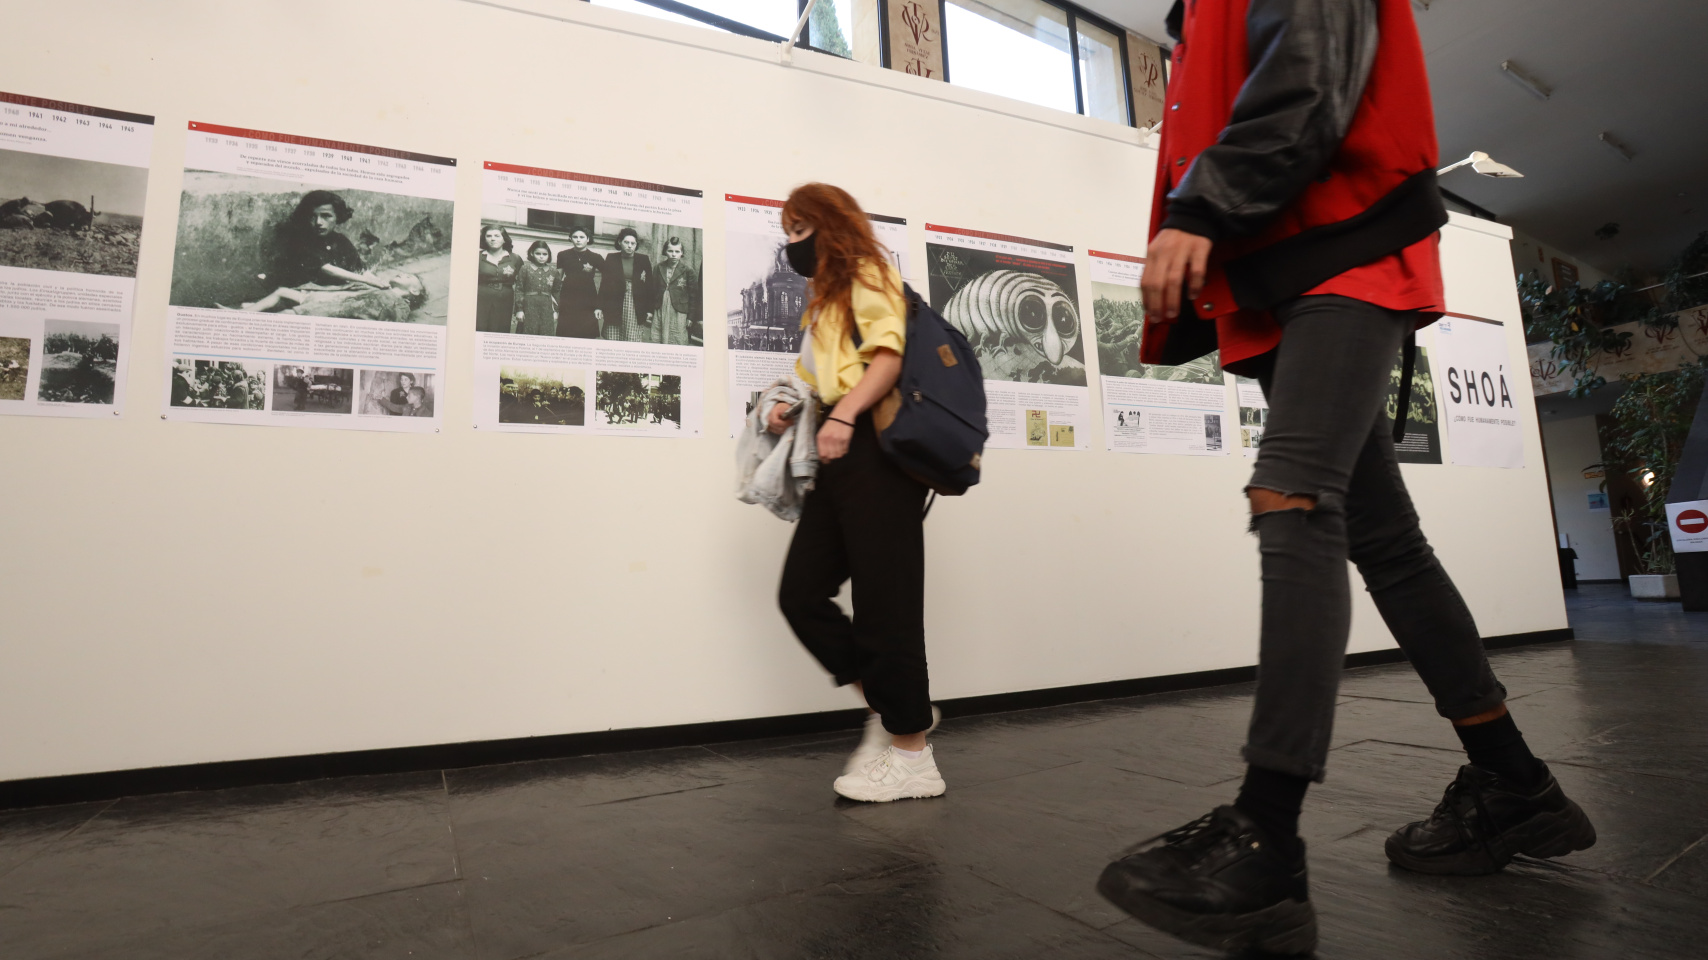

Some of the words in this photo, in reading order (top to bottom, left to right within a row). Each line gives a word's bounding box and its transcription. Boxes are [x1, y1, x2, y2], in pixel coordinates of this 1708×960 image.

[42, 100, 96, 115] POSIBLE?
[28, 111, 43, 119] 1941
[76, 118, 90, 126] 1943
[278, 135, 296, 143] FUE
[1448, 364, 1513, 408] SHOÁ
